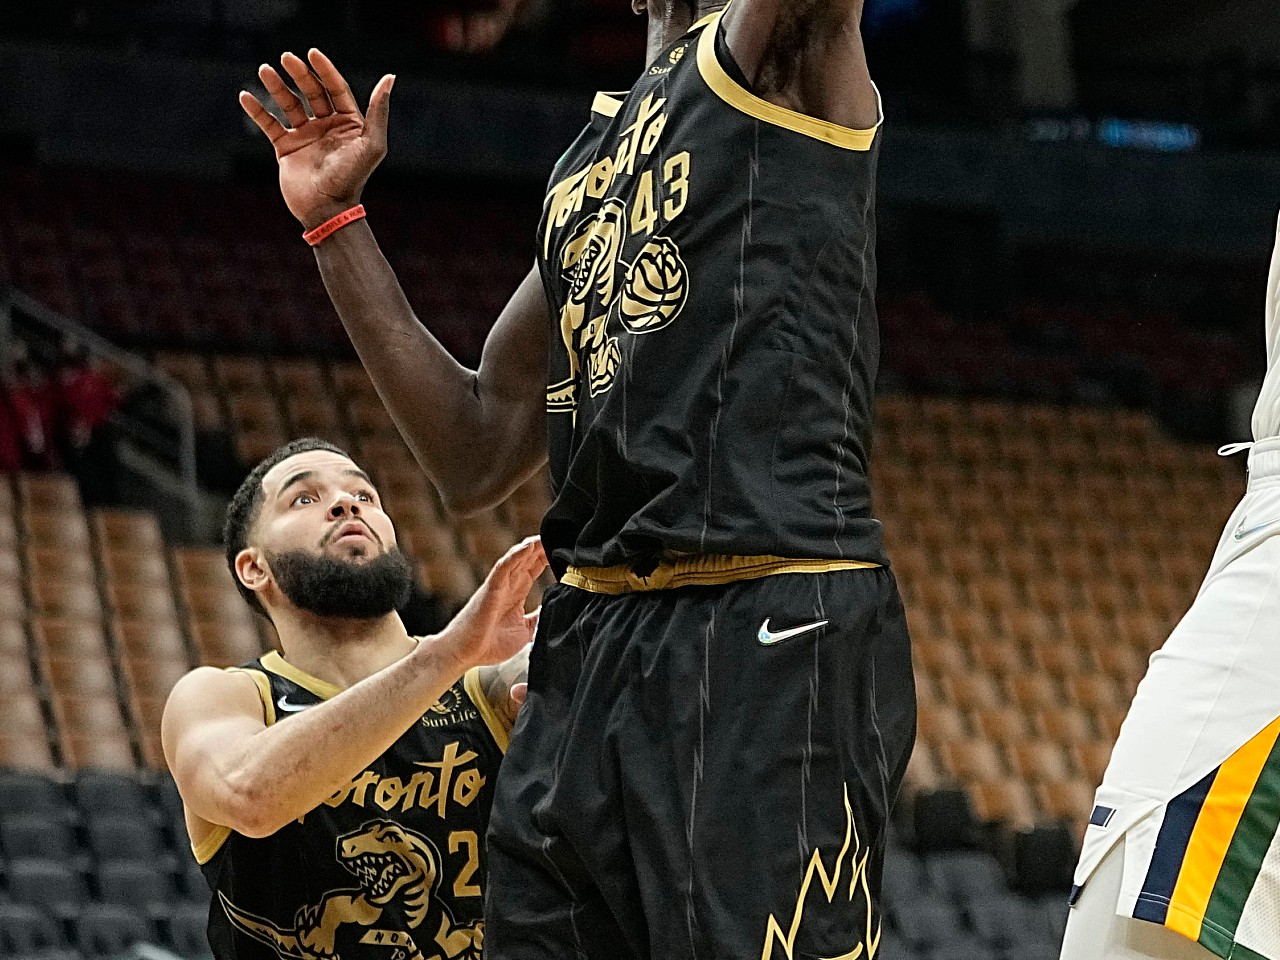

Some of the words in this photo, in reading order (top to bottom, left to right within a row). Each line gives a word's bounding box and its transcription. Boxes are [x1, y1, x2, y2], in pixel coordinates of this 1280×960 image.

[543, 91, 669, 261] Toronto
[630, 150, 691, 236] 43
[421, 716, 449, 728] Sun
[450, 709, 478, 724] Life
